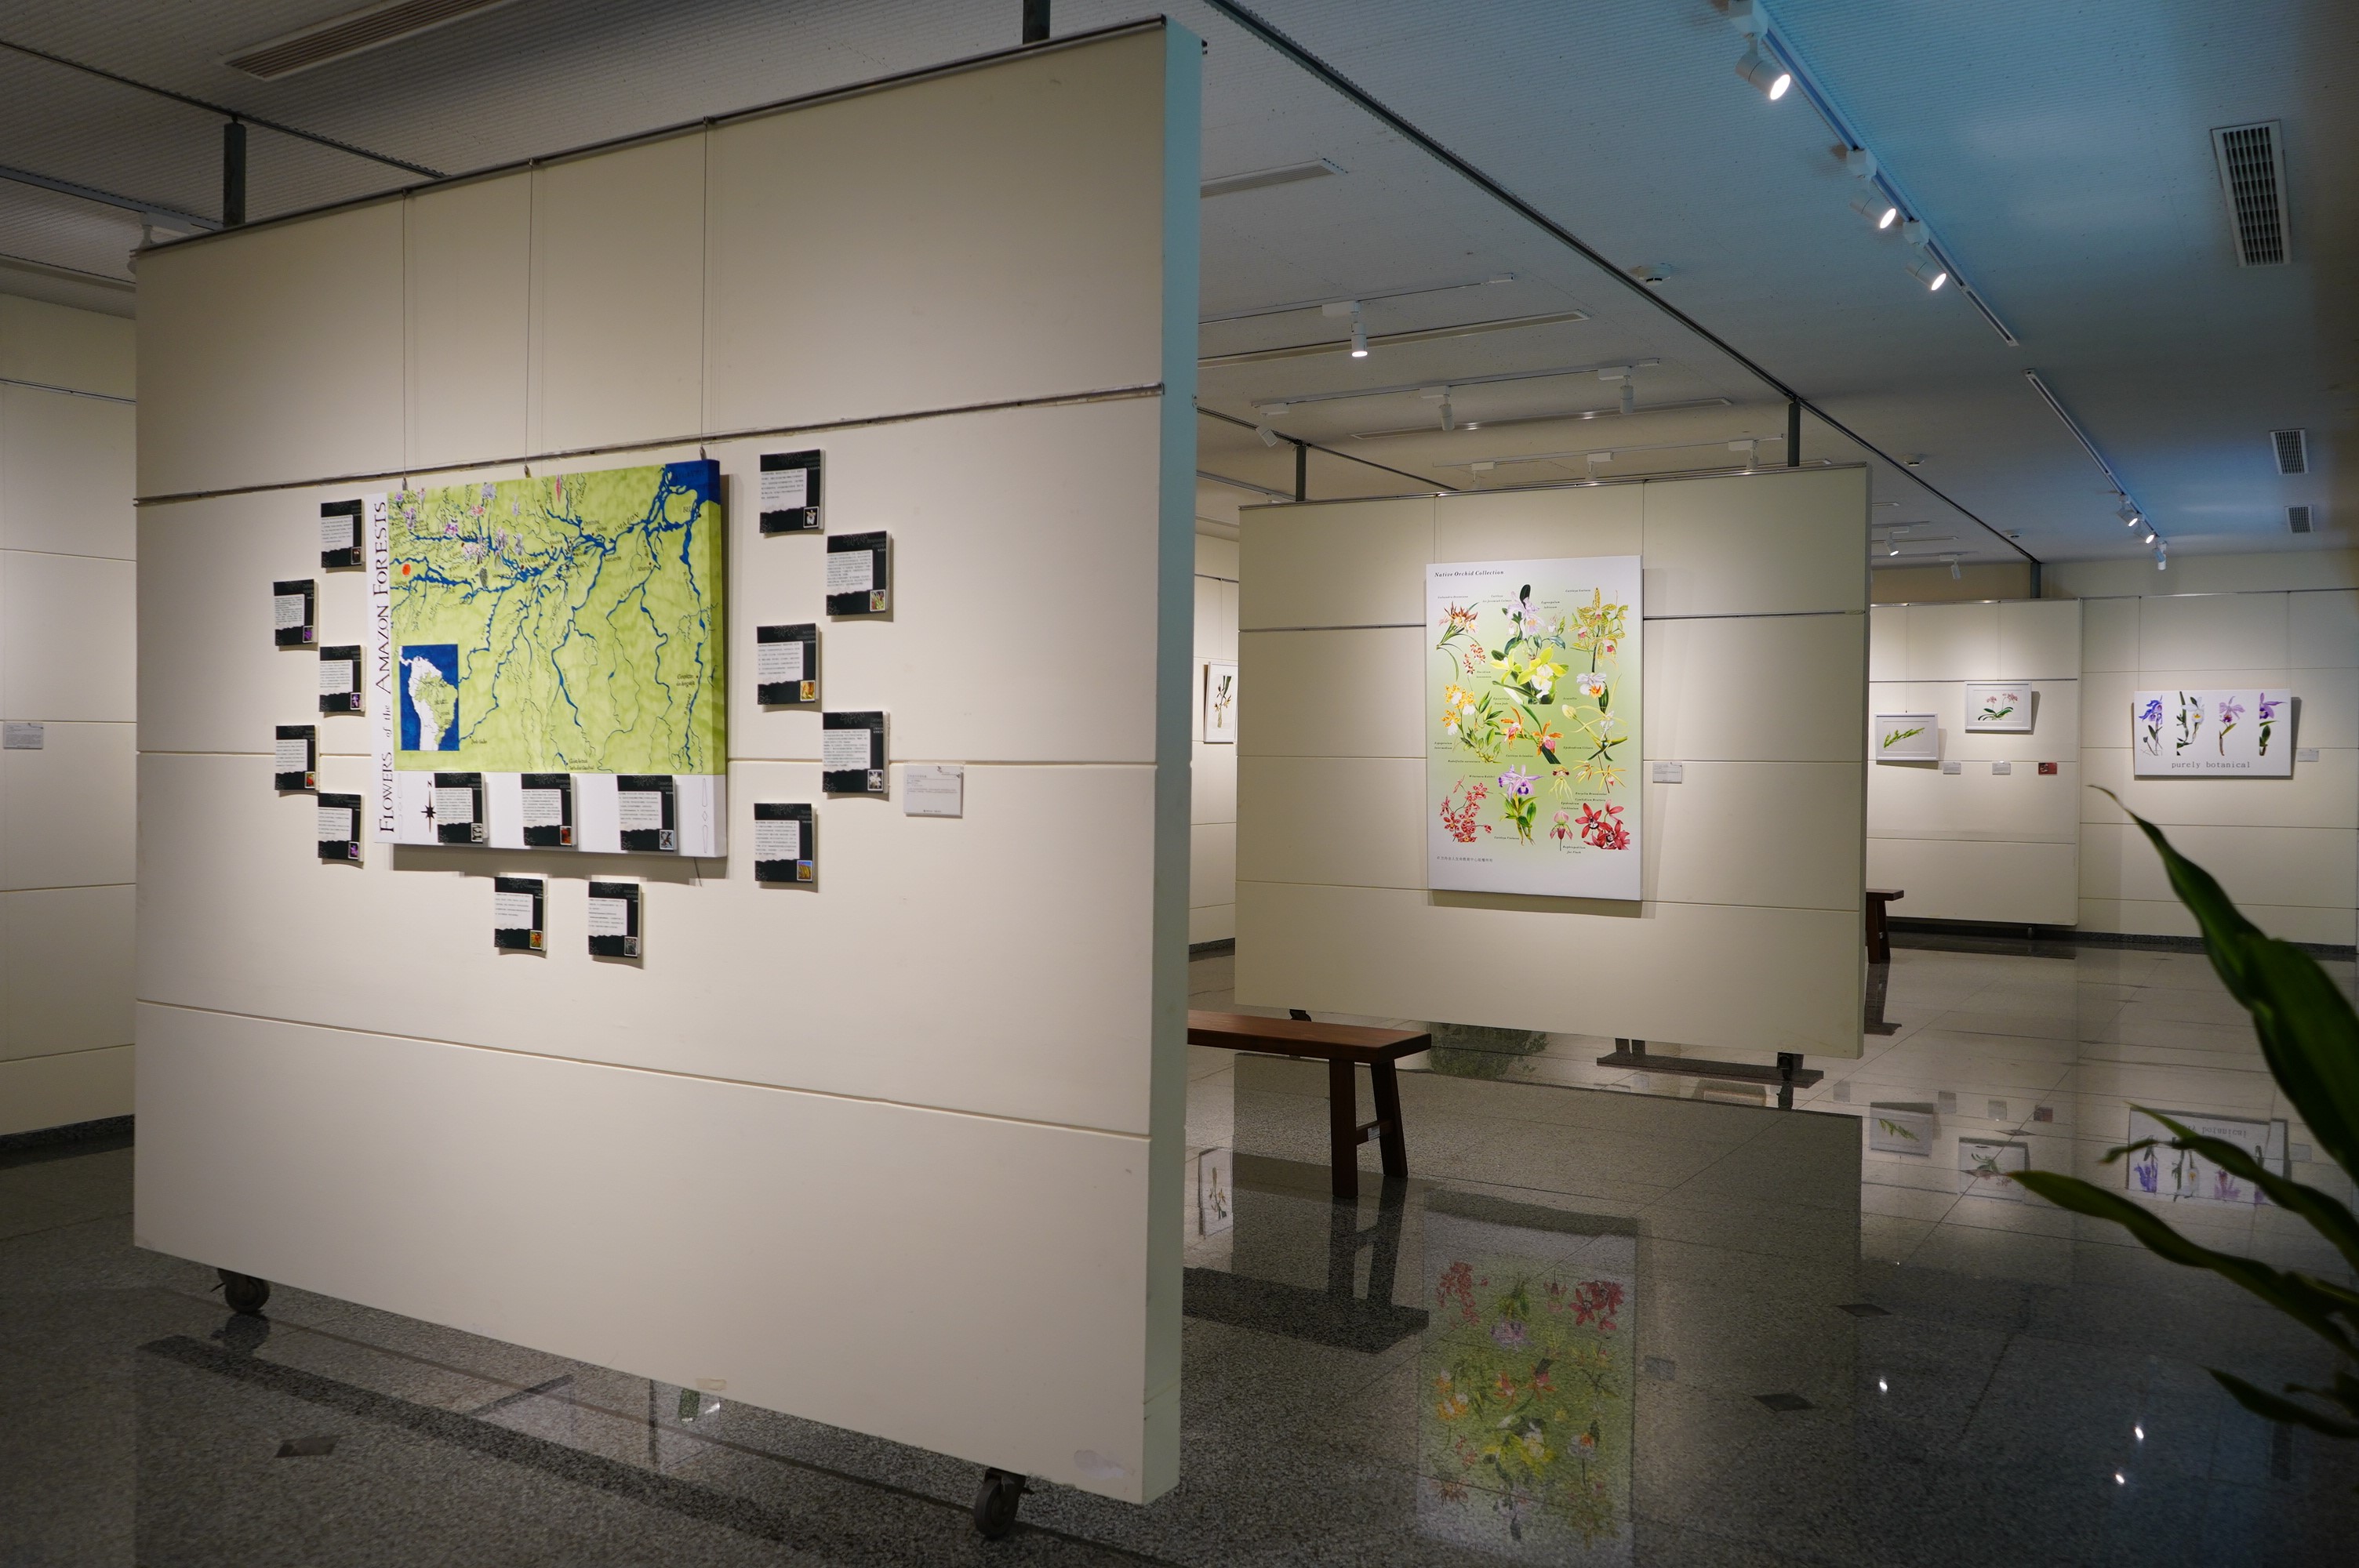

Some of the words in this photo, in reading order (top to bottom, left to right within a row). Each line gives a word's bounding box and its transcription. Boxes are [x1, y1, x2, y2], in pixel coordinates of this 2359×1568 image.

[373, 501, 388, 596] FORESTS
[375, 604, 391, 695] AMAZON
[383, 705, 391, 720] the
[386, 727, 393, 737] of
